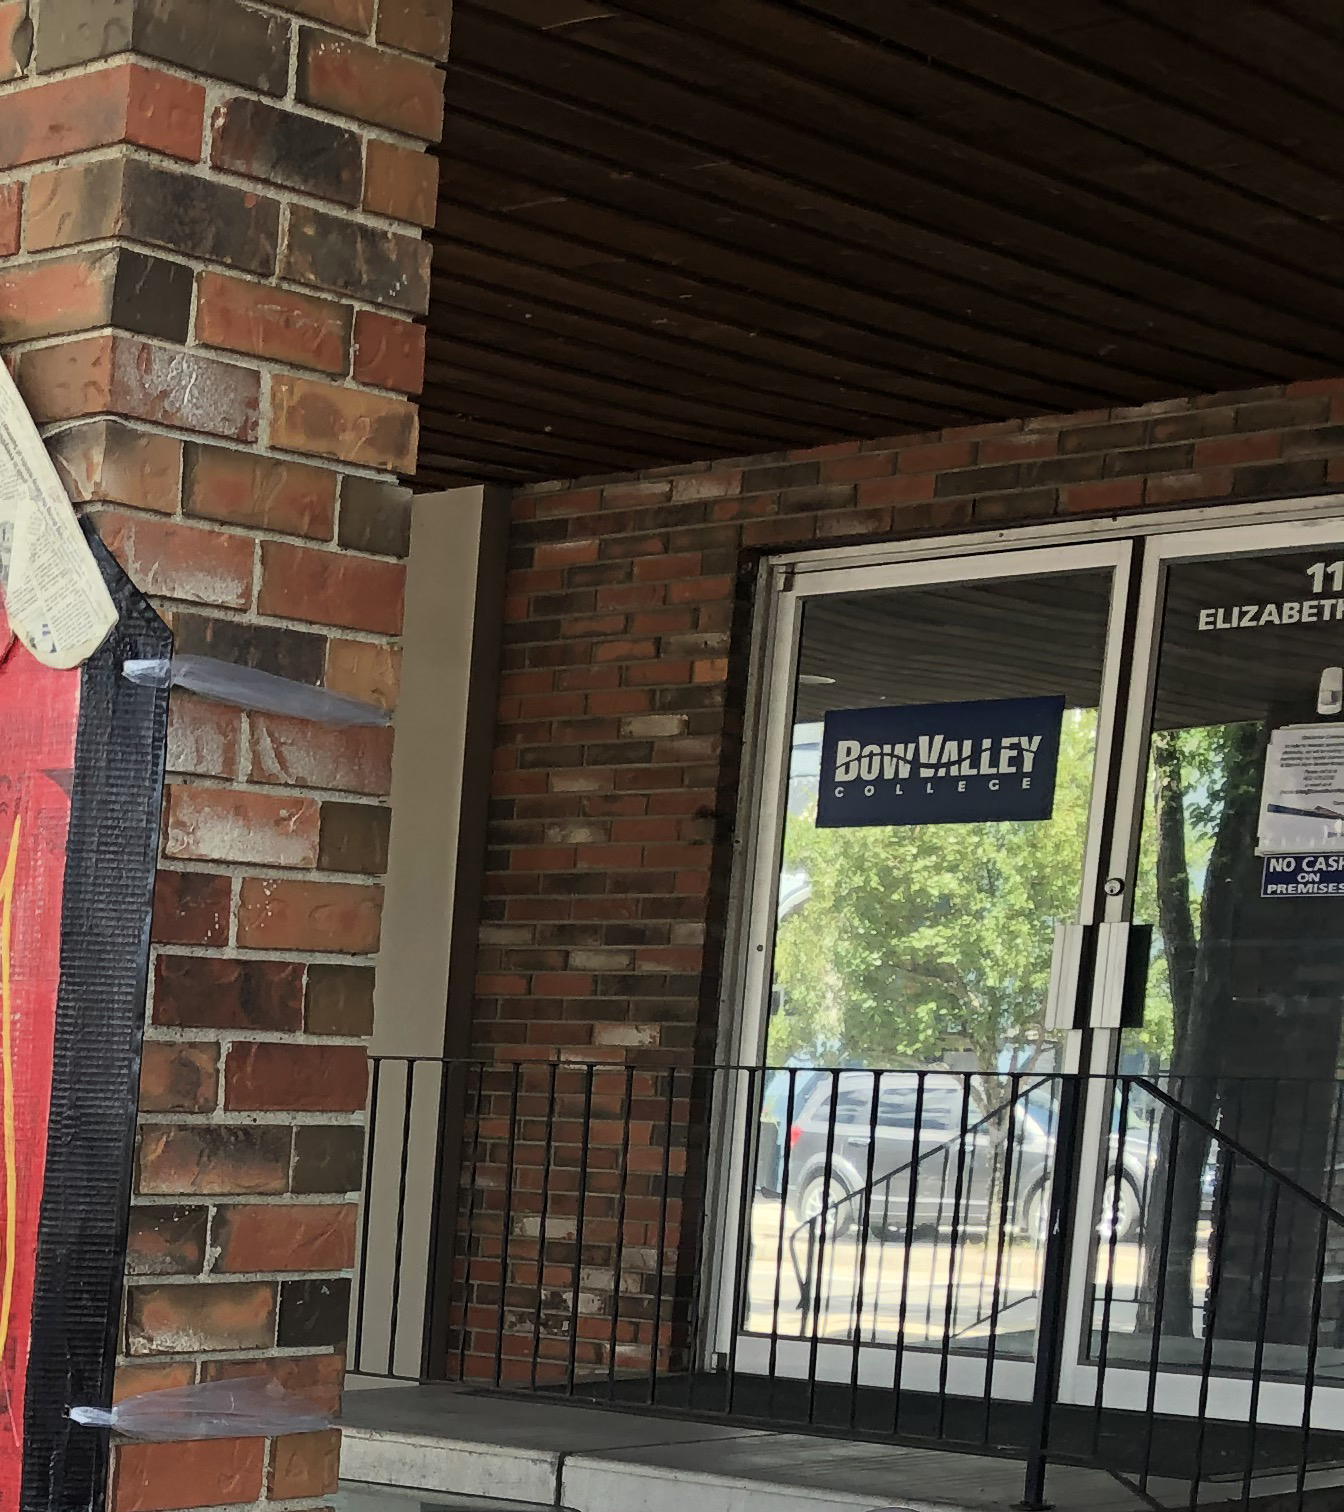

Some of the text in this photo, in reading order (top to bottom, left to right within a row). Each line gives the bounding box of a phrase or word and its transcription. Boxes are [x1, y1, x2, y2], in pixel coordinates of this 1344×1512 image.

[834, 777, 1031, 798] COLLEGE
[1268, 857, 1297, 872] NO
[1296, 872, 1321, 882] ON
